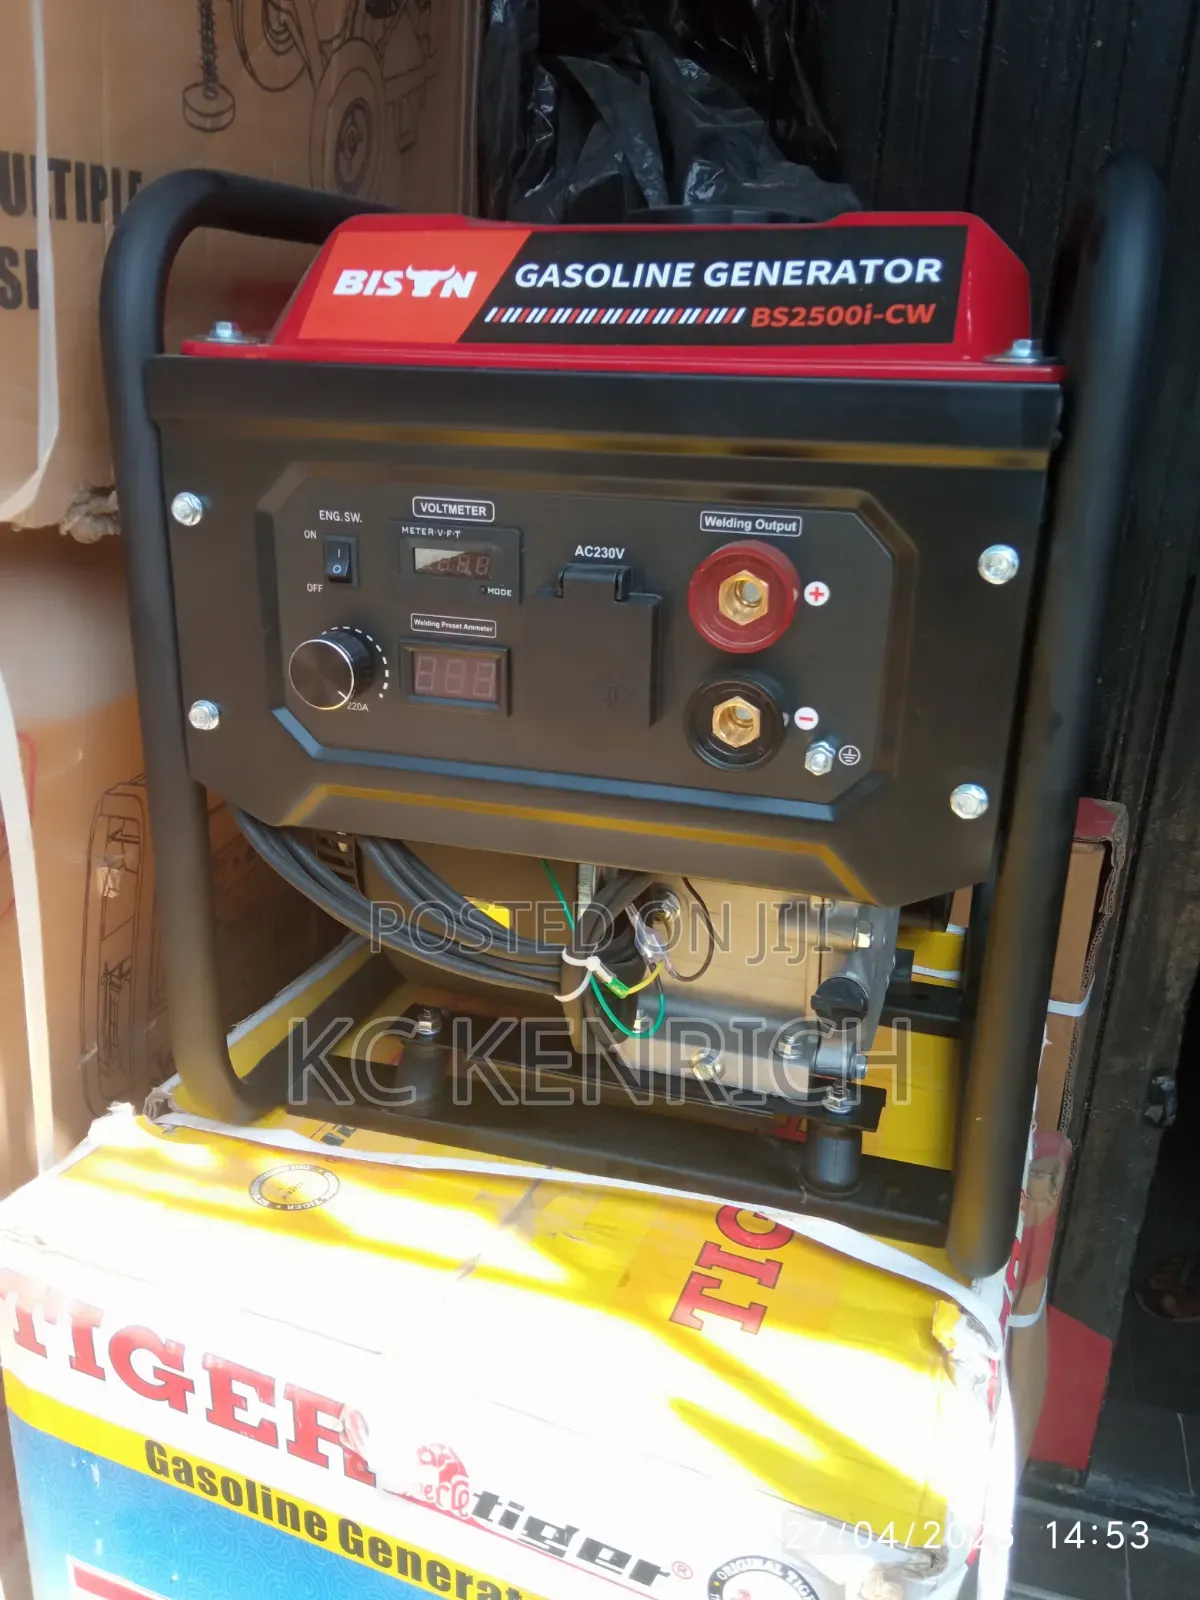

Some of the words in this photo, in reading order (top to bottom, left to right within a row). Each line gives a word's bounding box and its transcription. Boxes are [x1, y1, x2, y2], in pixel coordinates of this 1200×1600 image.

[514, 261, 695, 290] GASOLINE
[703, 258, 942, 288] GENERATOR
[750, 303, 936, 329] BS2500i-CW
[319, 509, 363, 524] ENG.SW.
[419, 501, 487, 518] VOLTMETER
[704, 515, 752, 531] Welding
[755, 518, 798, 534] Output
[303, 529, 318, 540] ON
[574, 545, 625, 560] AC230V
[306, 583, 324, 594] OFF
[487, 586, 512, 597] MODE
[413, 618, 440, 629] Welding
[441, 621, 463, 630] Preset
[463, 623, 493, 633] Ammeter
[346, 701, 369, 712] 220A
[144, 1438, 328, 1541] Gasoline
[472, 1490, 671, 1587] tiger
